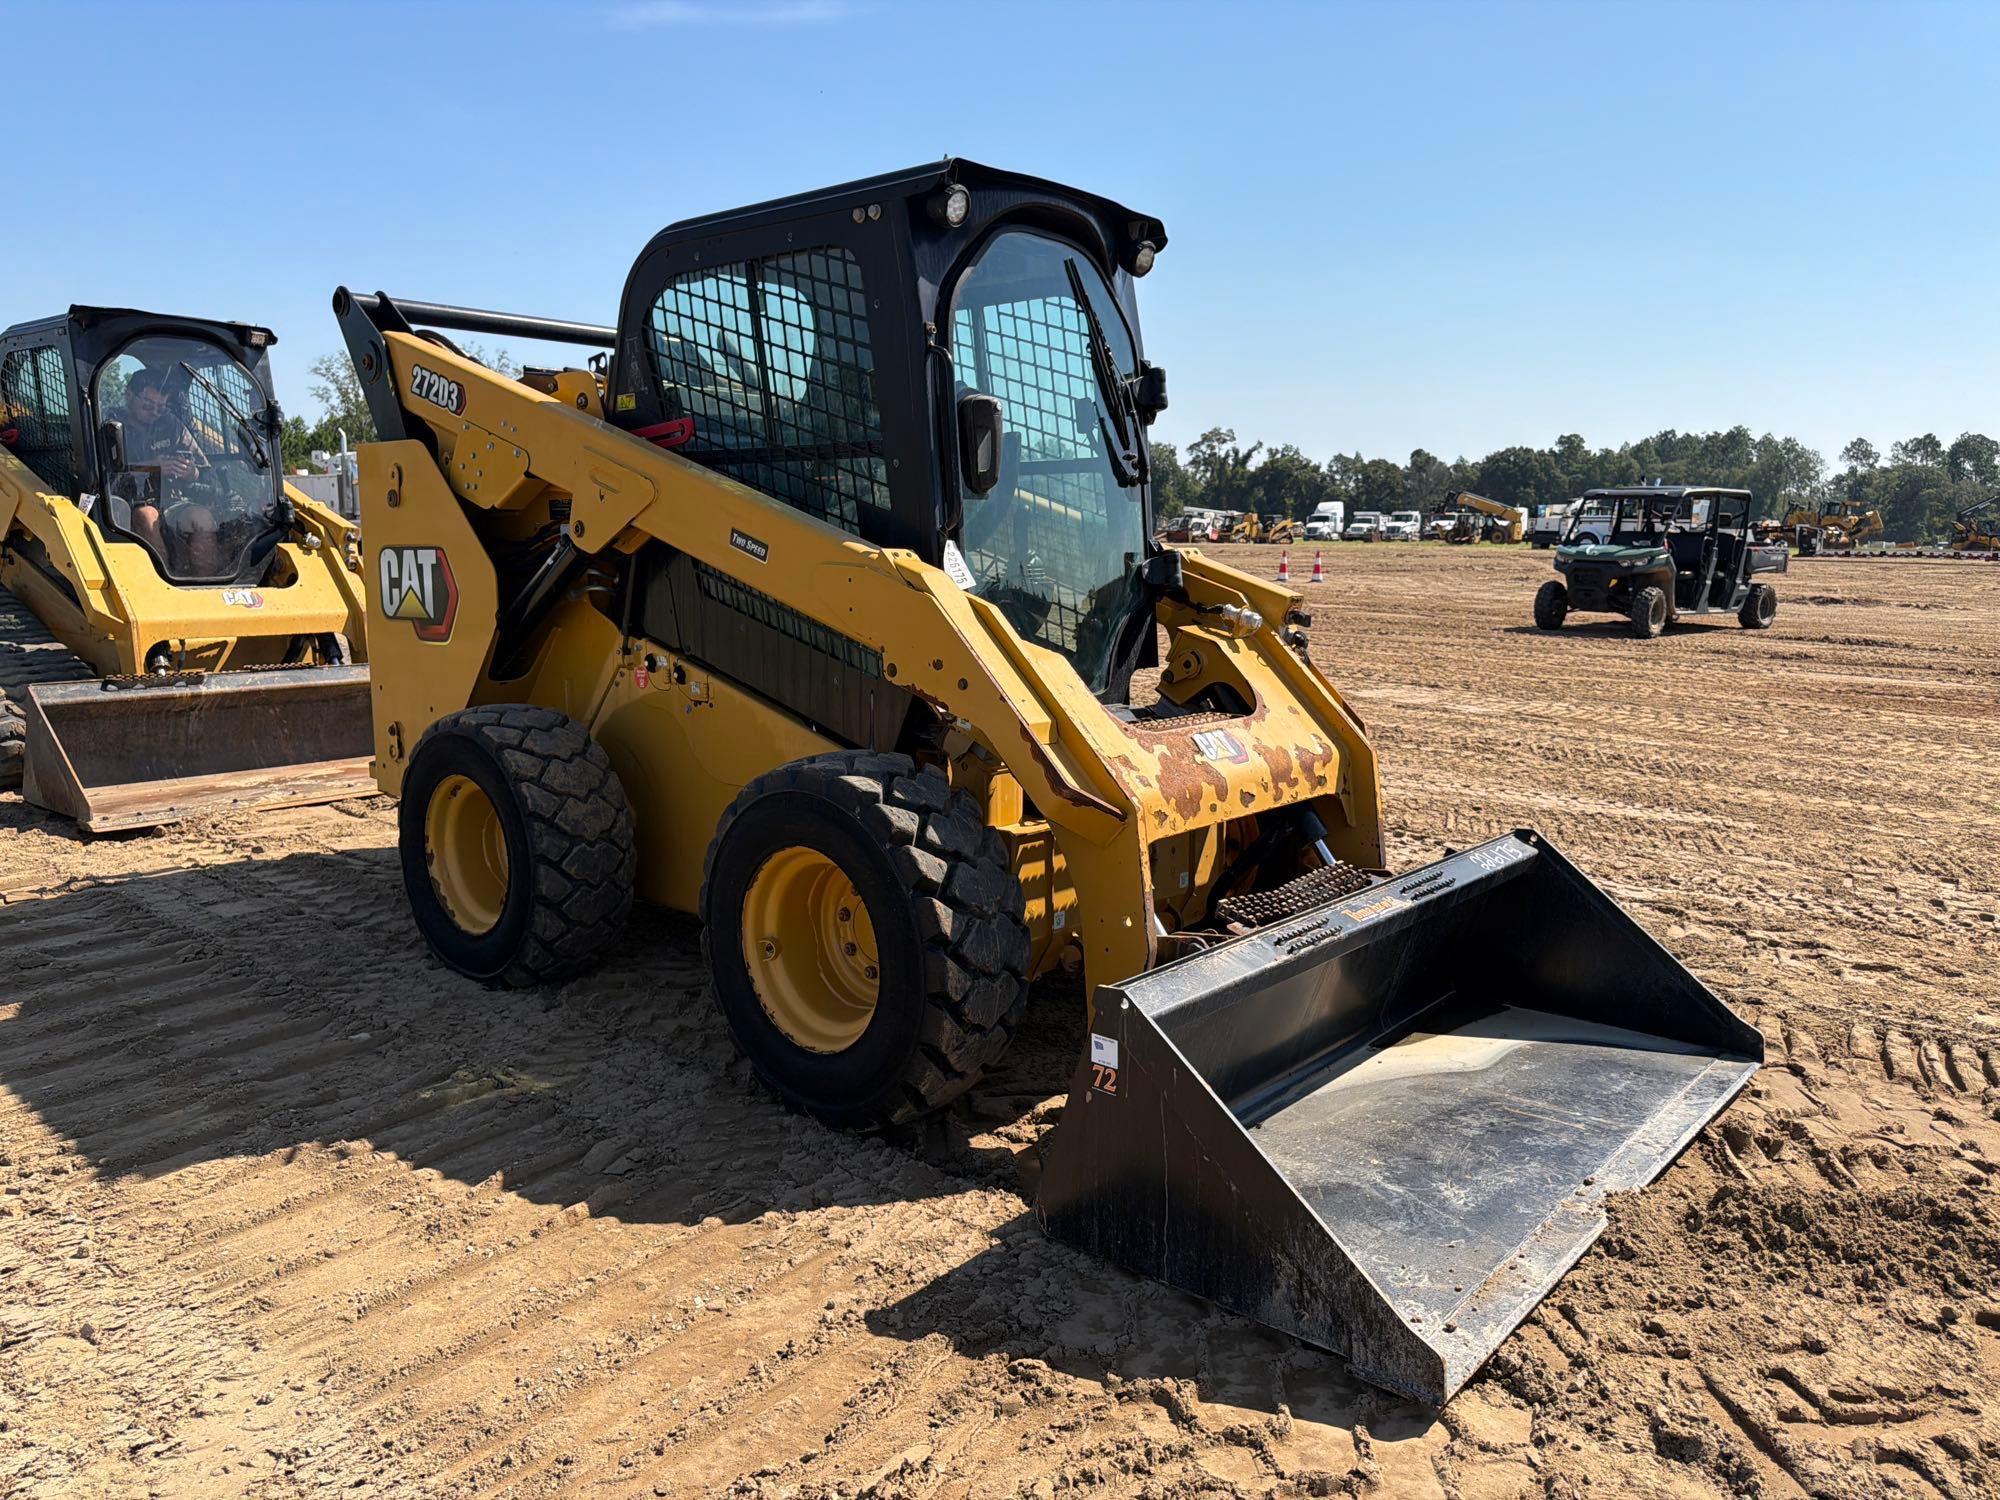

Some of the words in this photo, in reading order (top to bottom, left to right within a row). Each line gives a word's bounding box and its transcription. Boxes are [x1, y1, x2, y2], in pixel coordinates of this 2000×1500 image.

[411, 364, 459, 412] 272D3
[222, 590, 255, 606] CAT
[380, 547, 437, 619] CAT
[1193, 729, 1238, 760] CAT
[1092, 1064, 1117, 1092] 72
